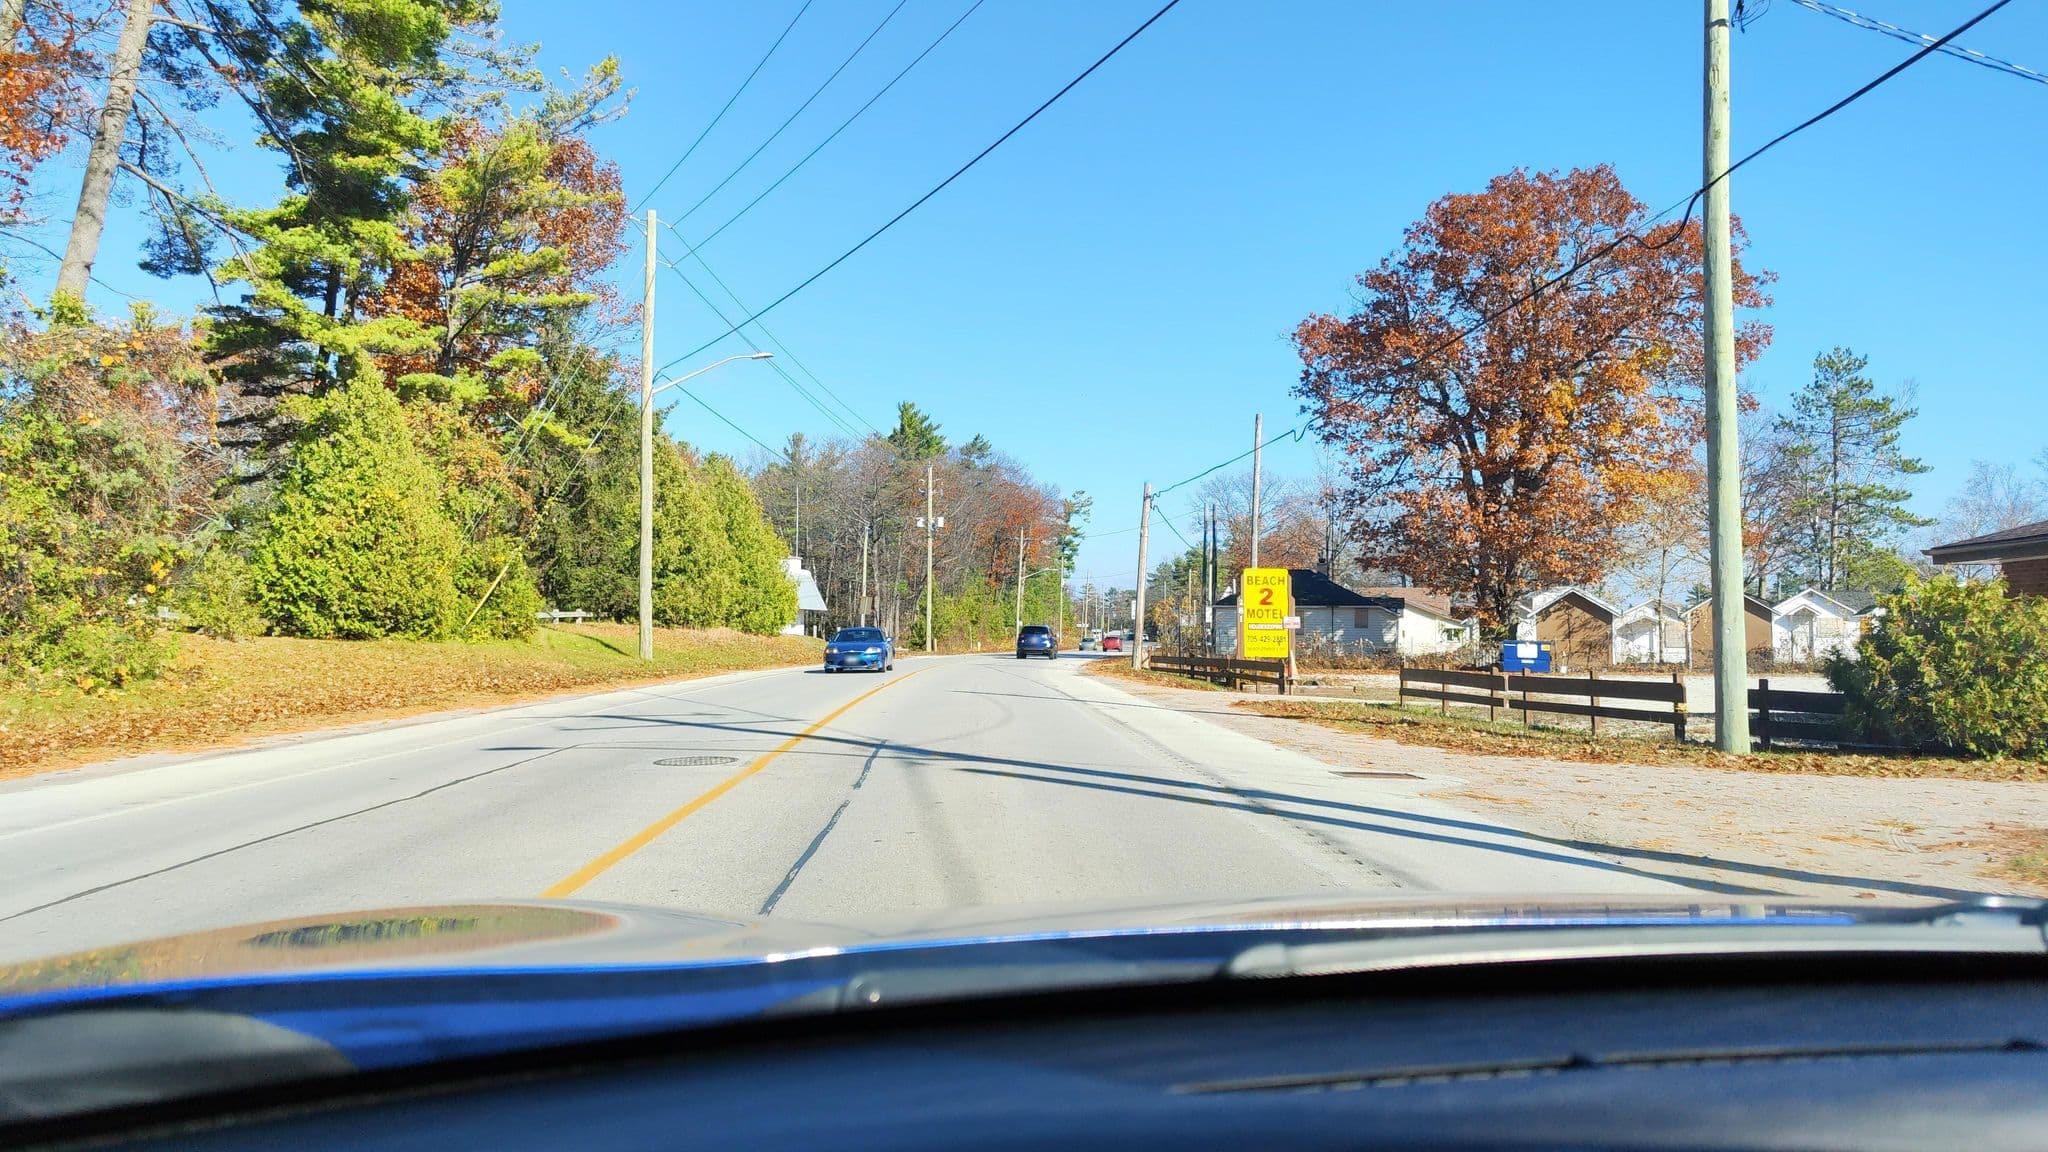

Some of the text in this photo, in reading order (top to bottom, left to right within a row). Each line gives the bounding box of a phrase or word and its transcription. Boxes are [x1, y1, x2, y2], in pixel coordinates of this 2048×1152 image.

[1247, 576, 1285, 585] BEACH
[1259, 588, 1273, 605] 2
[1247, 609, 1283, 619] MOTEL
